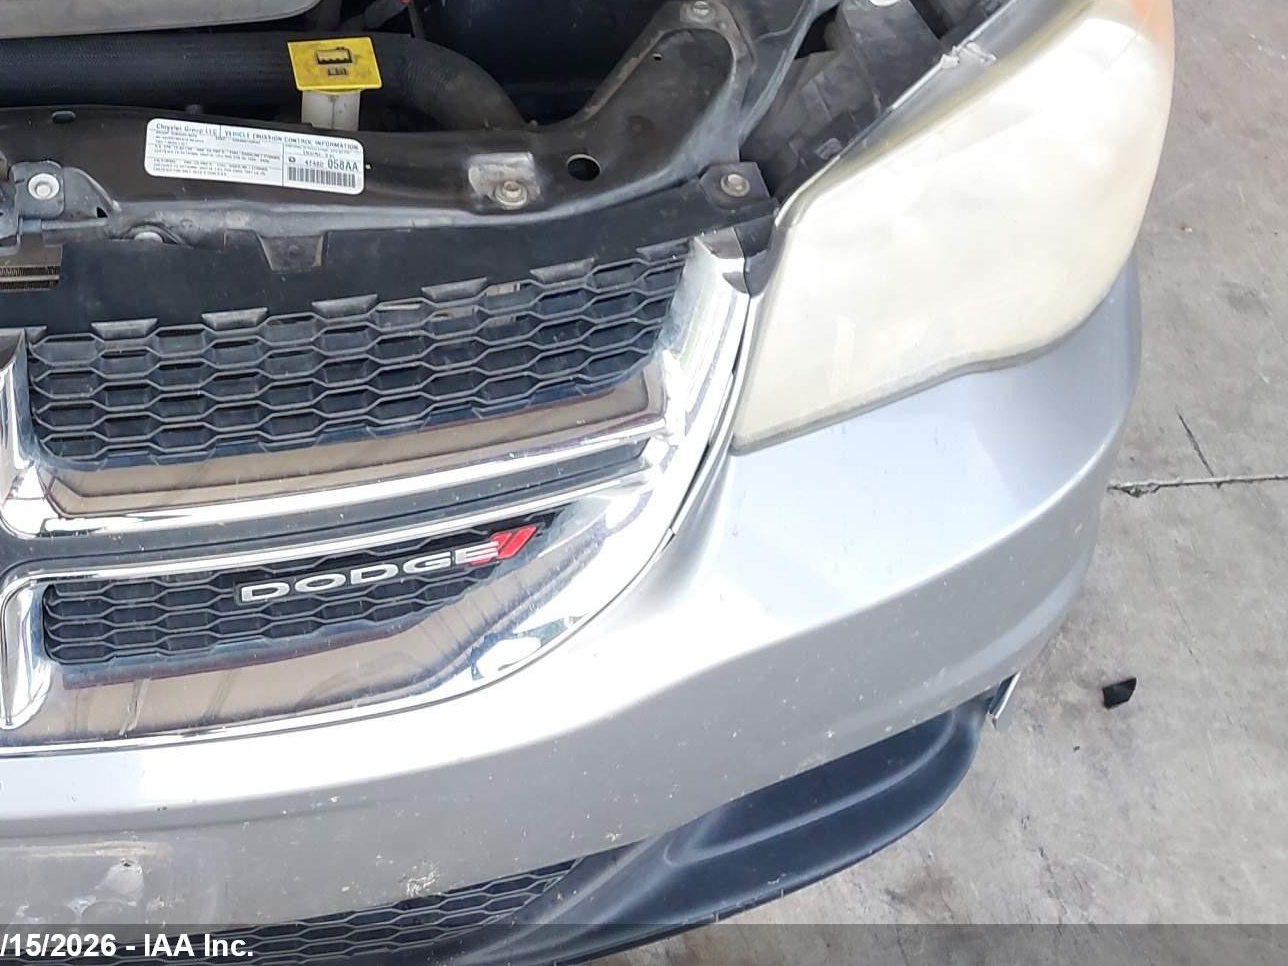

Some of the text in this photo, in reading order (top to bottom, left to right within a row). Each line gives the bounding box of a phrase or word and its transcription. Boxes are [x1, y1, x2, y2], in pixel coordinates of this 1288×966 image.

[224, 129, 250, 138] VEHICLE
[284, 136, 312, 145] CONTROL
[314, 139, 359, 150] INFORMATION
[327, 158, 359, 172] 058AA
[240, 540, 499, 602] DODGE
